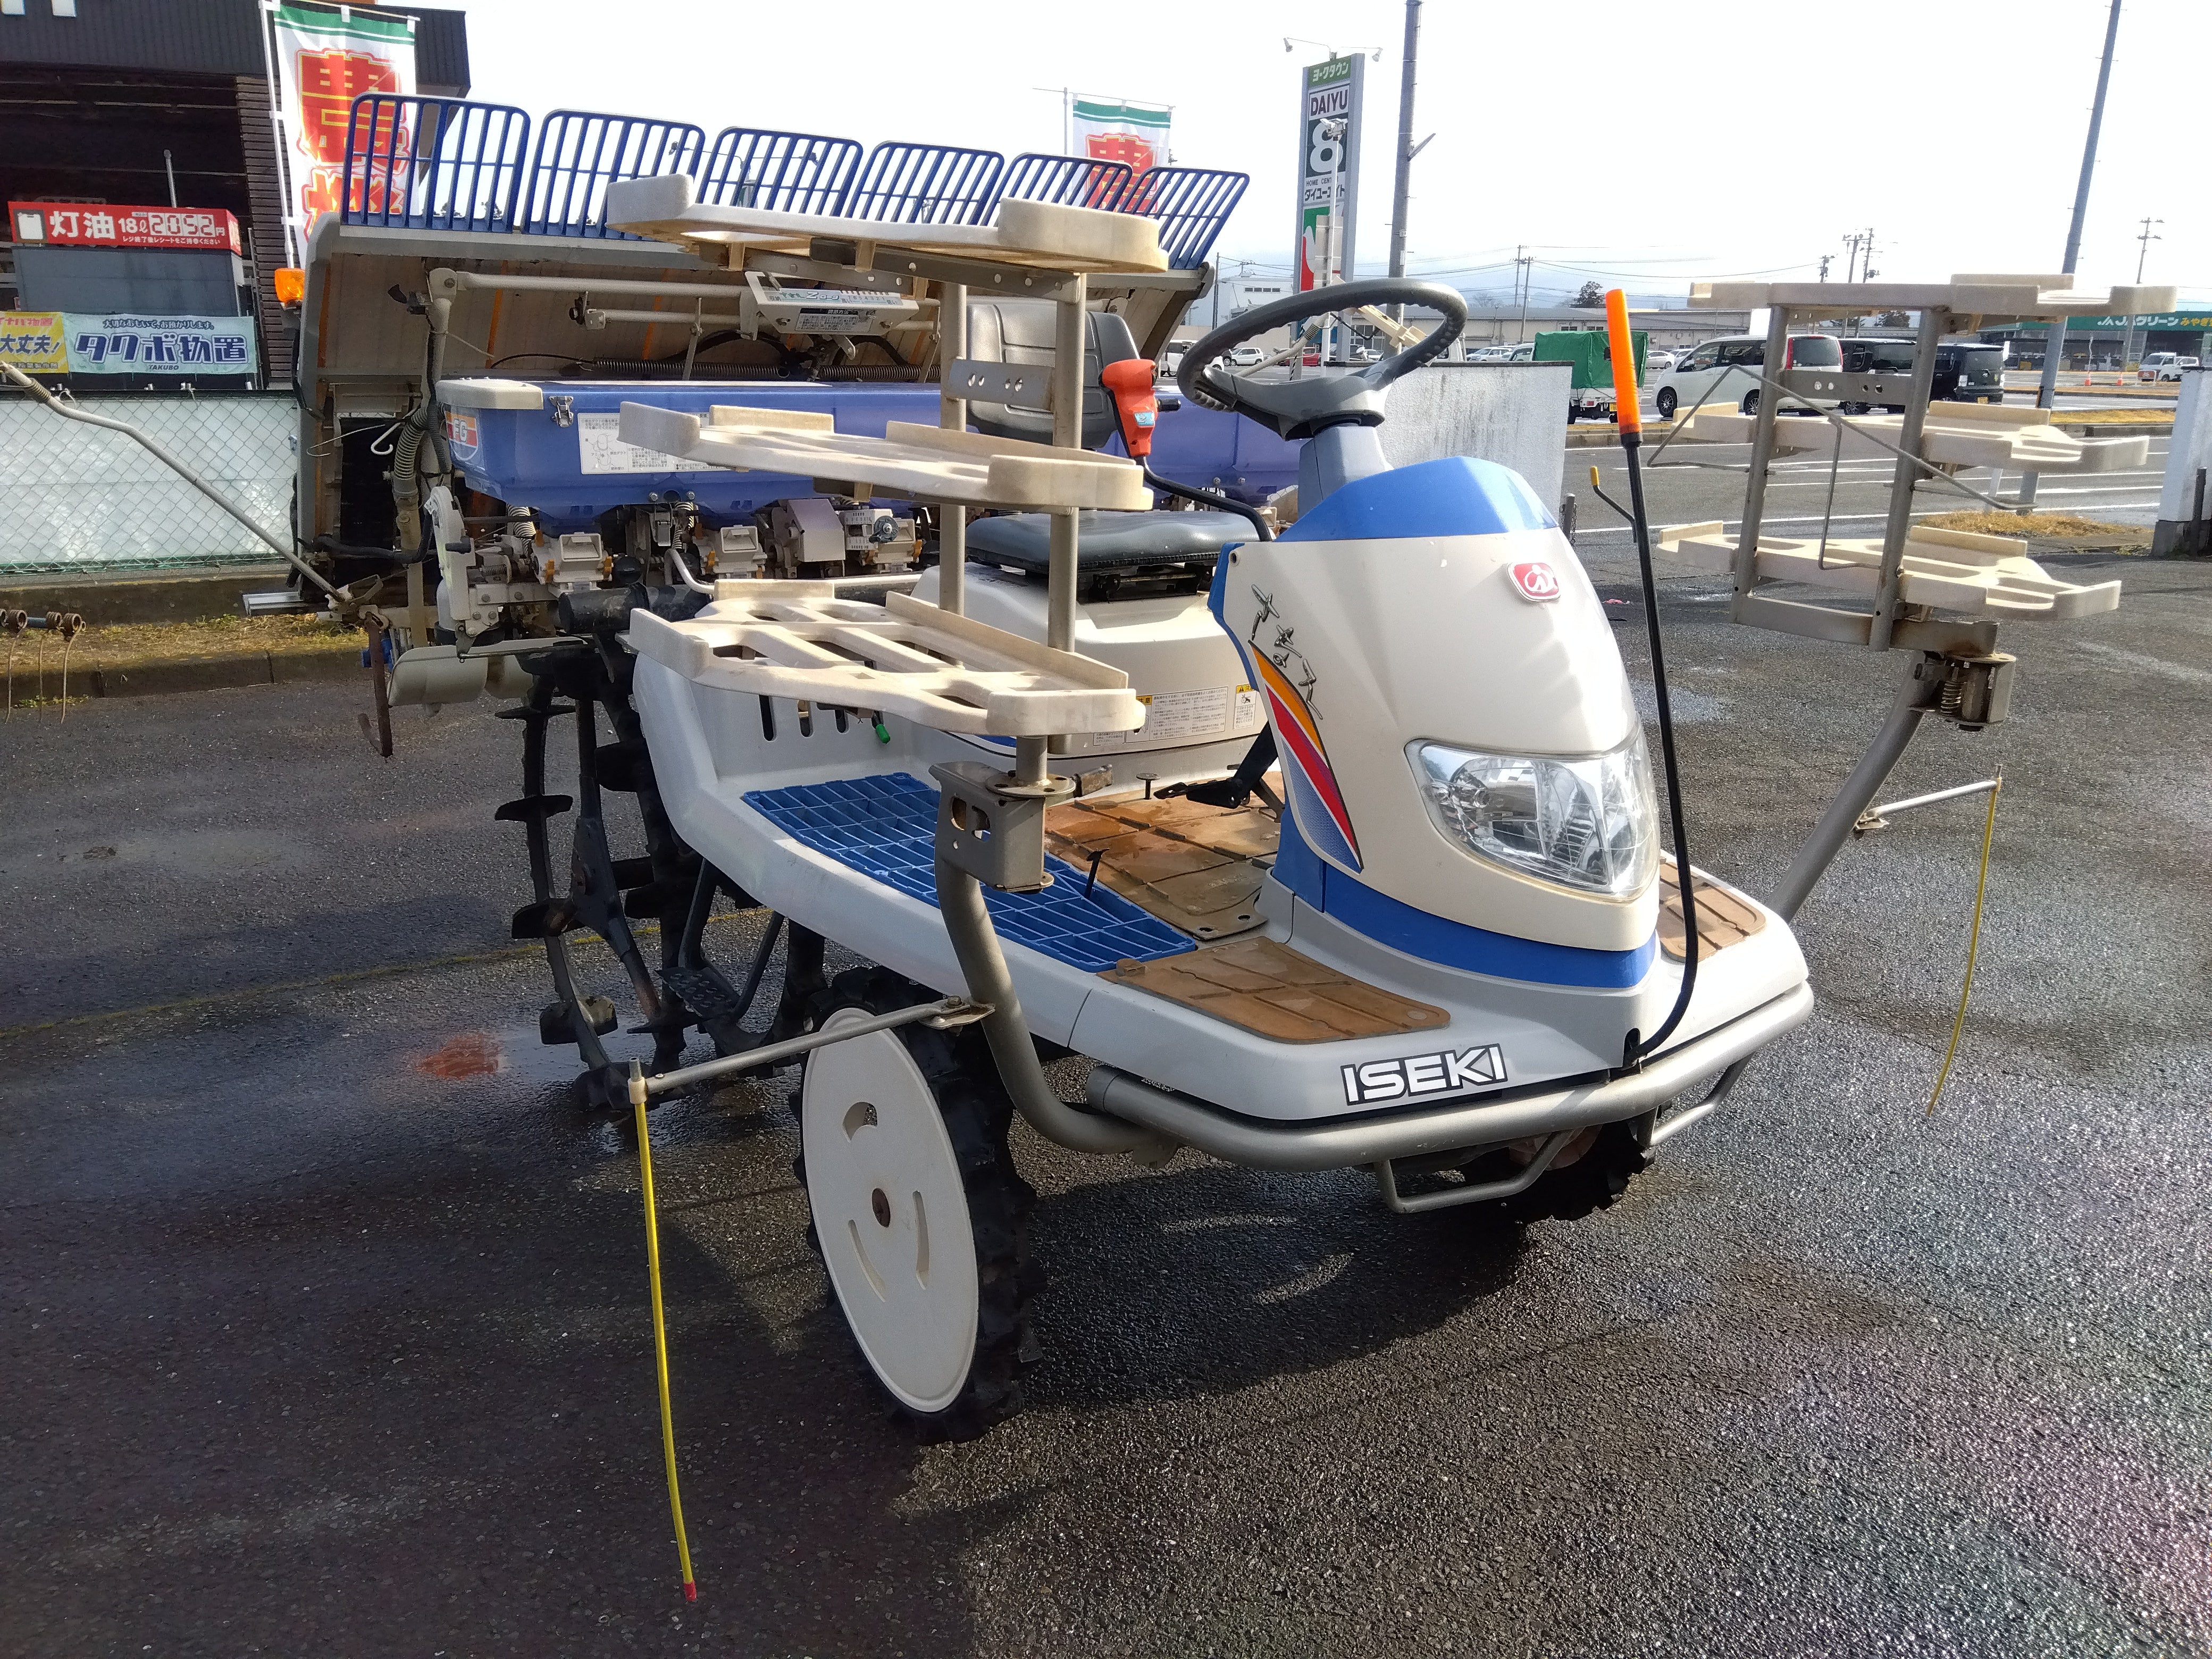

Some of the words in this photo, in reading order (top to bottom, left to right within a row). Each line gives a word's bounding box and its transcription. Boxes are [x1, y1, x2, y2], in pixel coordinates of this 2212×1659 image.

[1312, 62, 1348, 82] ヨークタウン
[1310, 89, 1348, 116] DAIYU
[1310, 121, 1343, 172] 8
[1321, 176, 1338, 185] CENTR
[49, 211, 116, 239] 灯油
[0, 333, 60, 354] 大丈夫!
[75, 332, 248, 364] タクボ物置
[454, 418, 467, 442] FG
[1340, 1043, 1507, 1105] ISEKI
